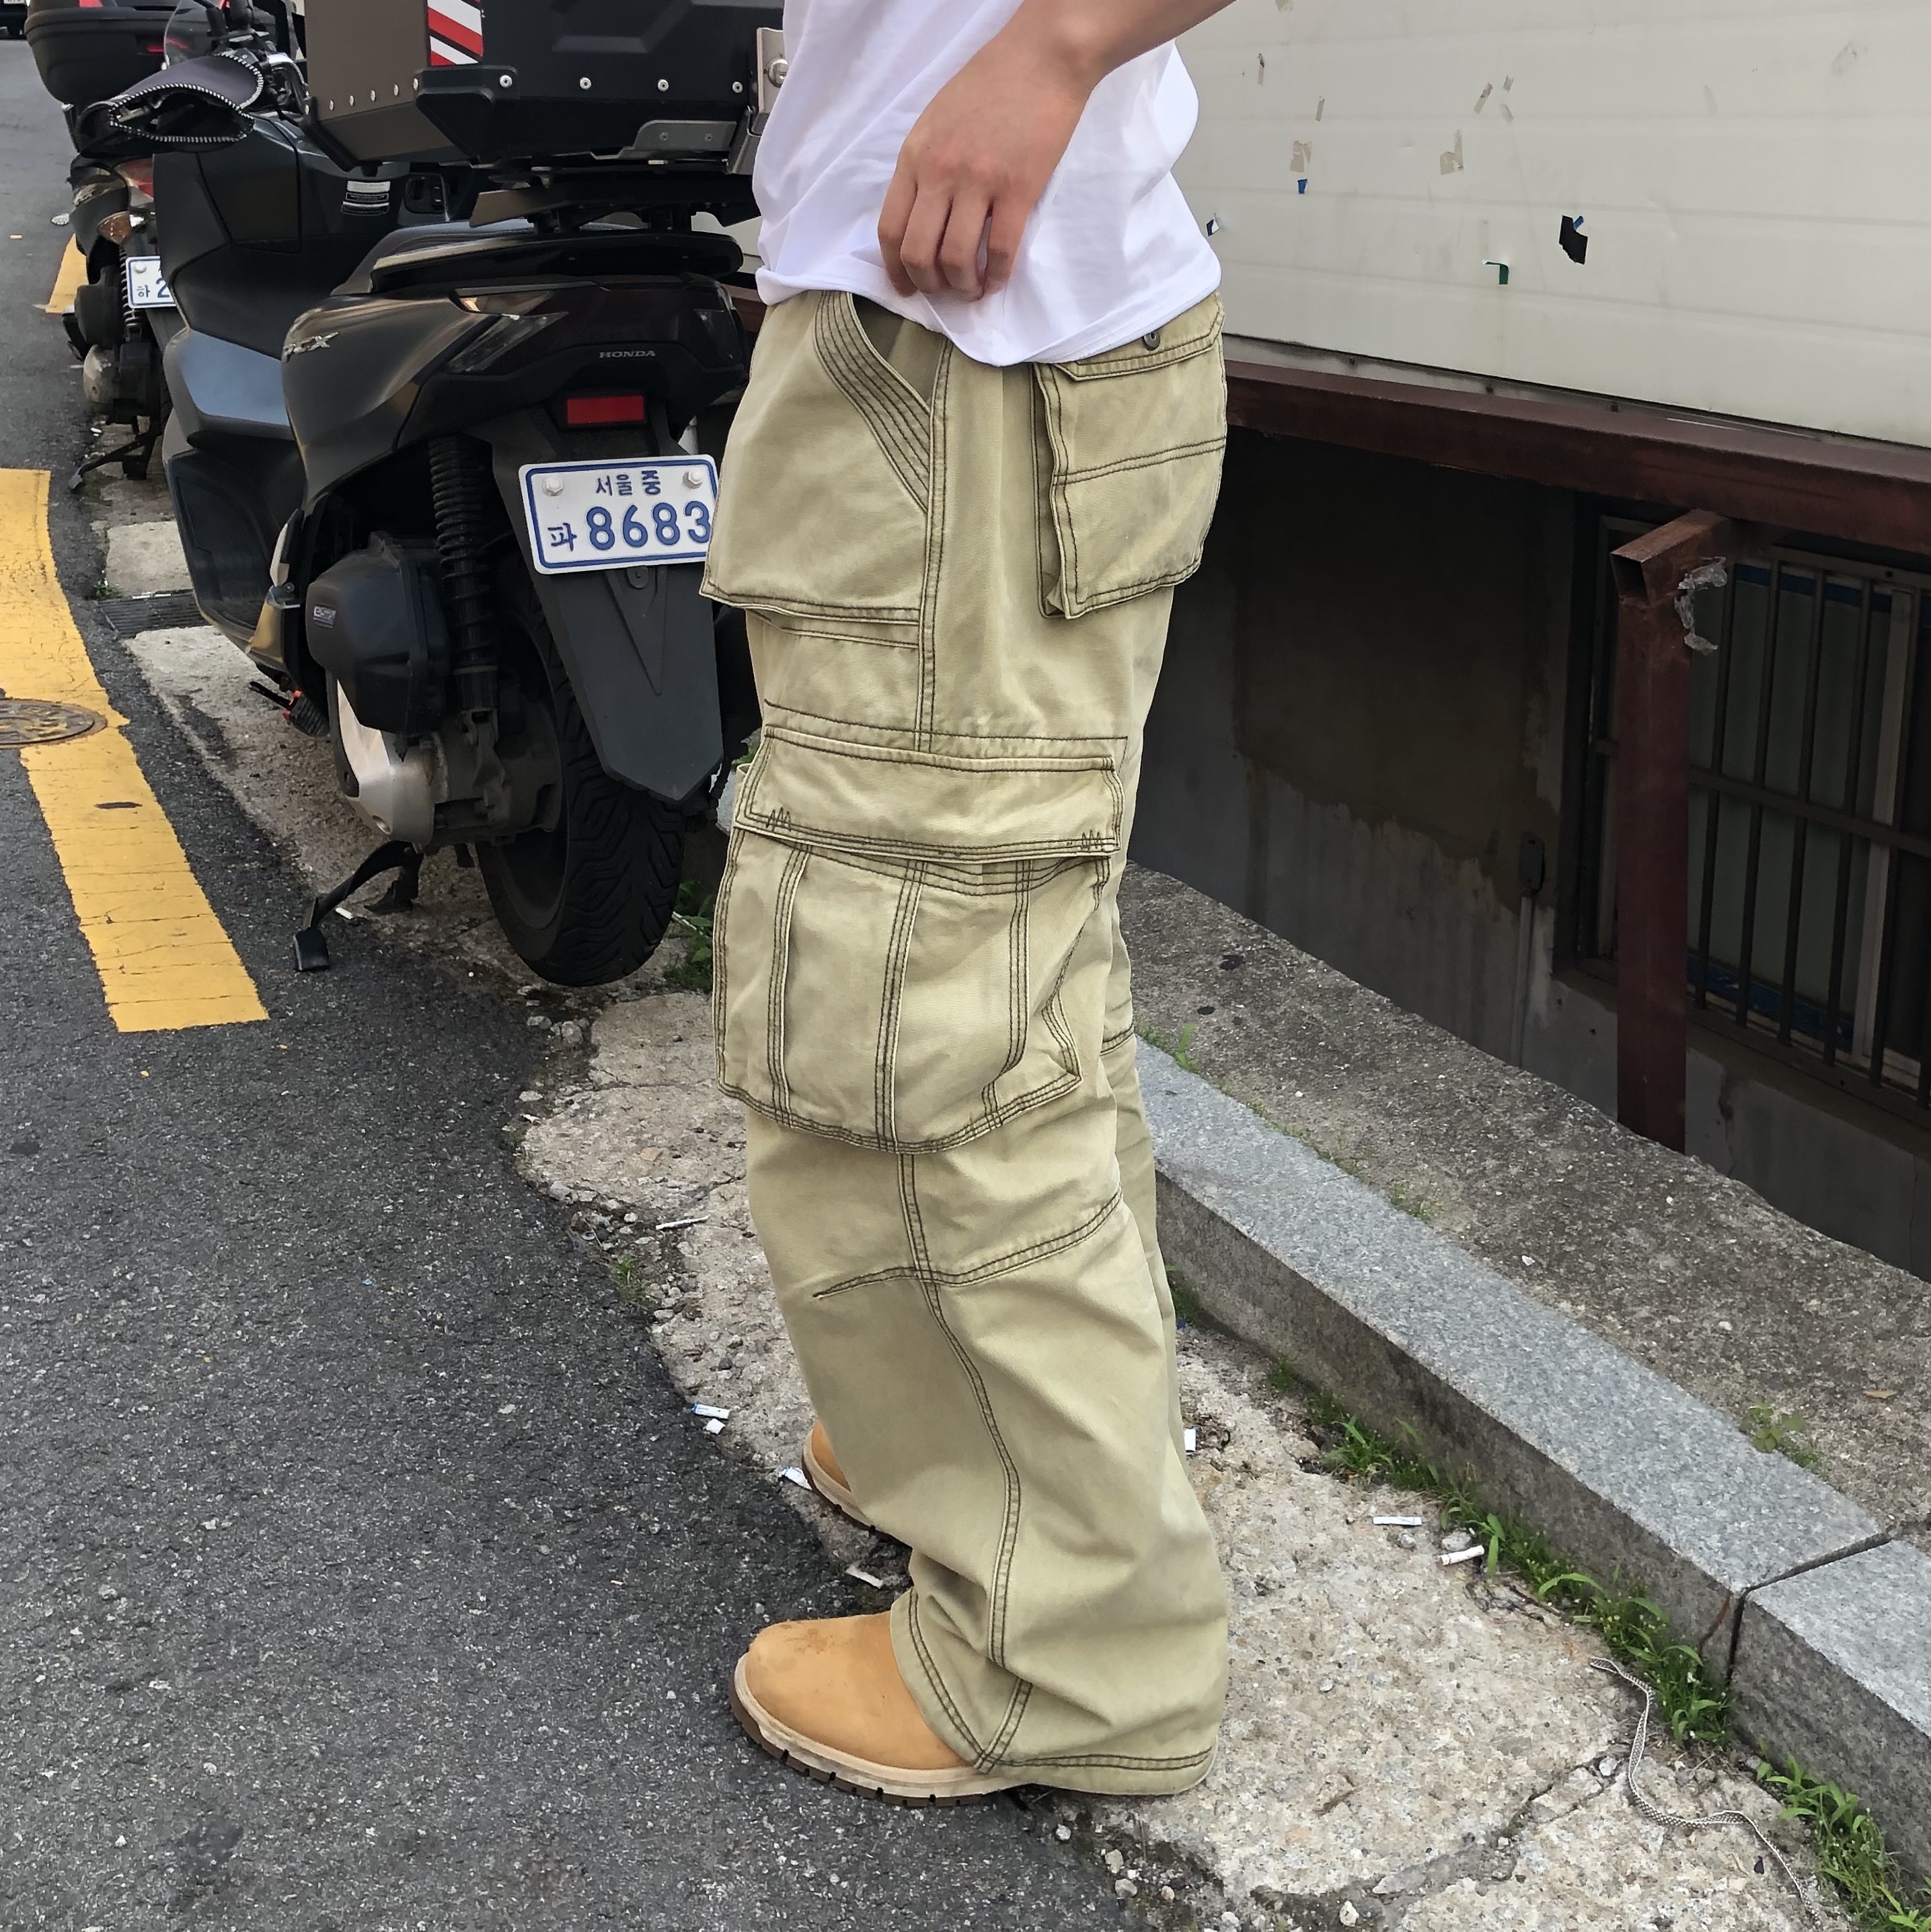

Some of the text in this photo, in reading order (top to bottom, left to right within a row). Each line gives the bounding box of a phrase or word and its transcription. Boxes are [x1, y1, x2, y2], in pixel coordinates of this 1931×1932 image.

[136, 284, 151, 298] 하
[599, 350, 656, 358] HONDA
[595, 469, 661, 496] 서울 중
[547, 500, 711, 551] 파 8683
